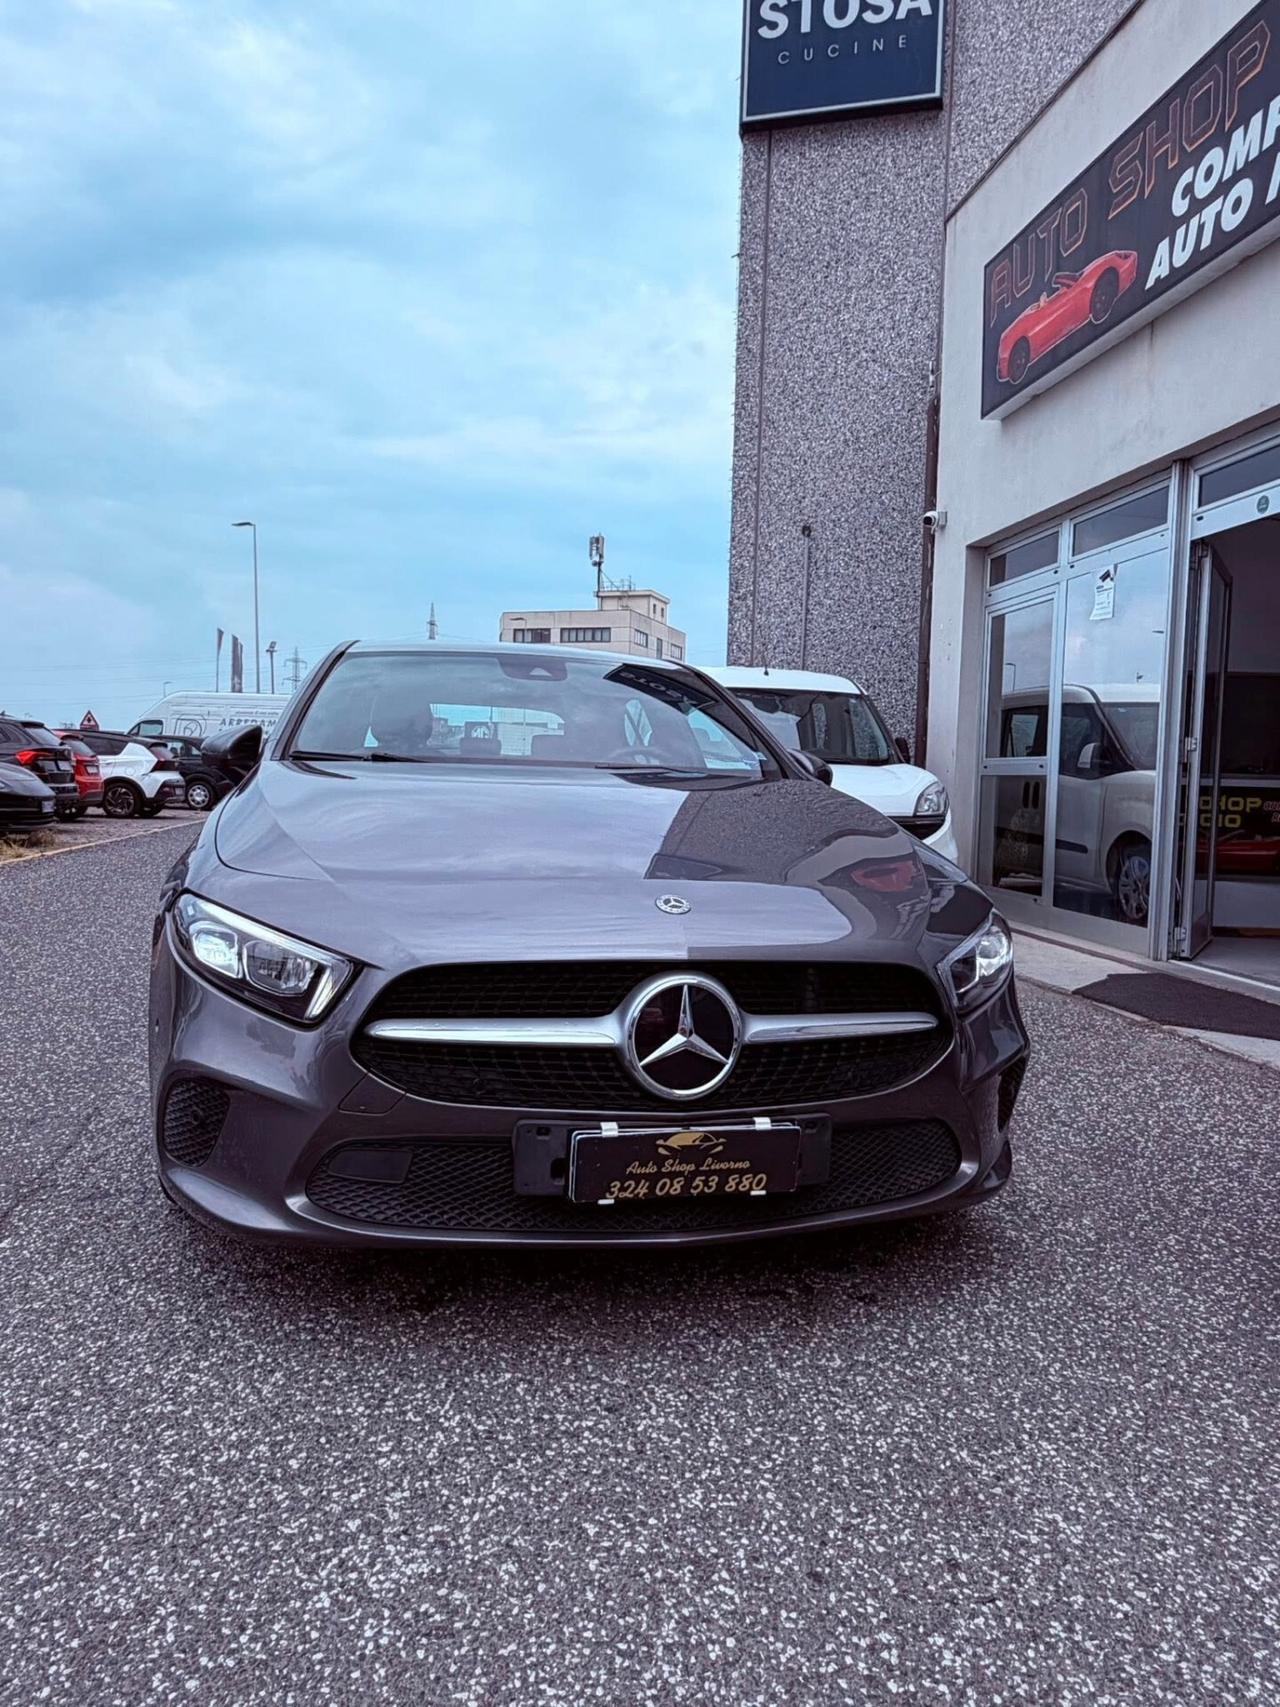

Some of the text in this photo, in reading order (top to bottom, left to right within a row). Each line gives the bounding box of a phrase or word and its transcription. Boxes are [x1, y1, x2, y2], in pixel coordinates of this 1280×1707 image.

[757, 0, 934, 39] STOSA
[777, 35, 907, 65] CUCINE
[990, 20, 1271, 328] AUTO SHOP
[1145, 177, 1254, 290] AUTO
[626, 1157, 751, 1175] Auto Shop Livorno
[606, 1173, 767, 1199] 324 08 53 880
